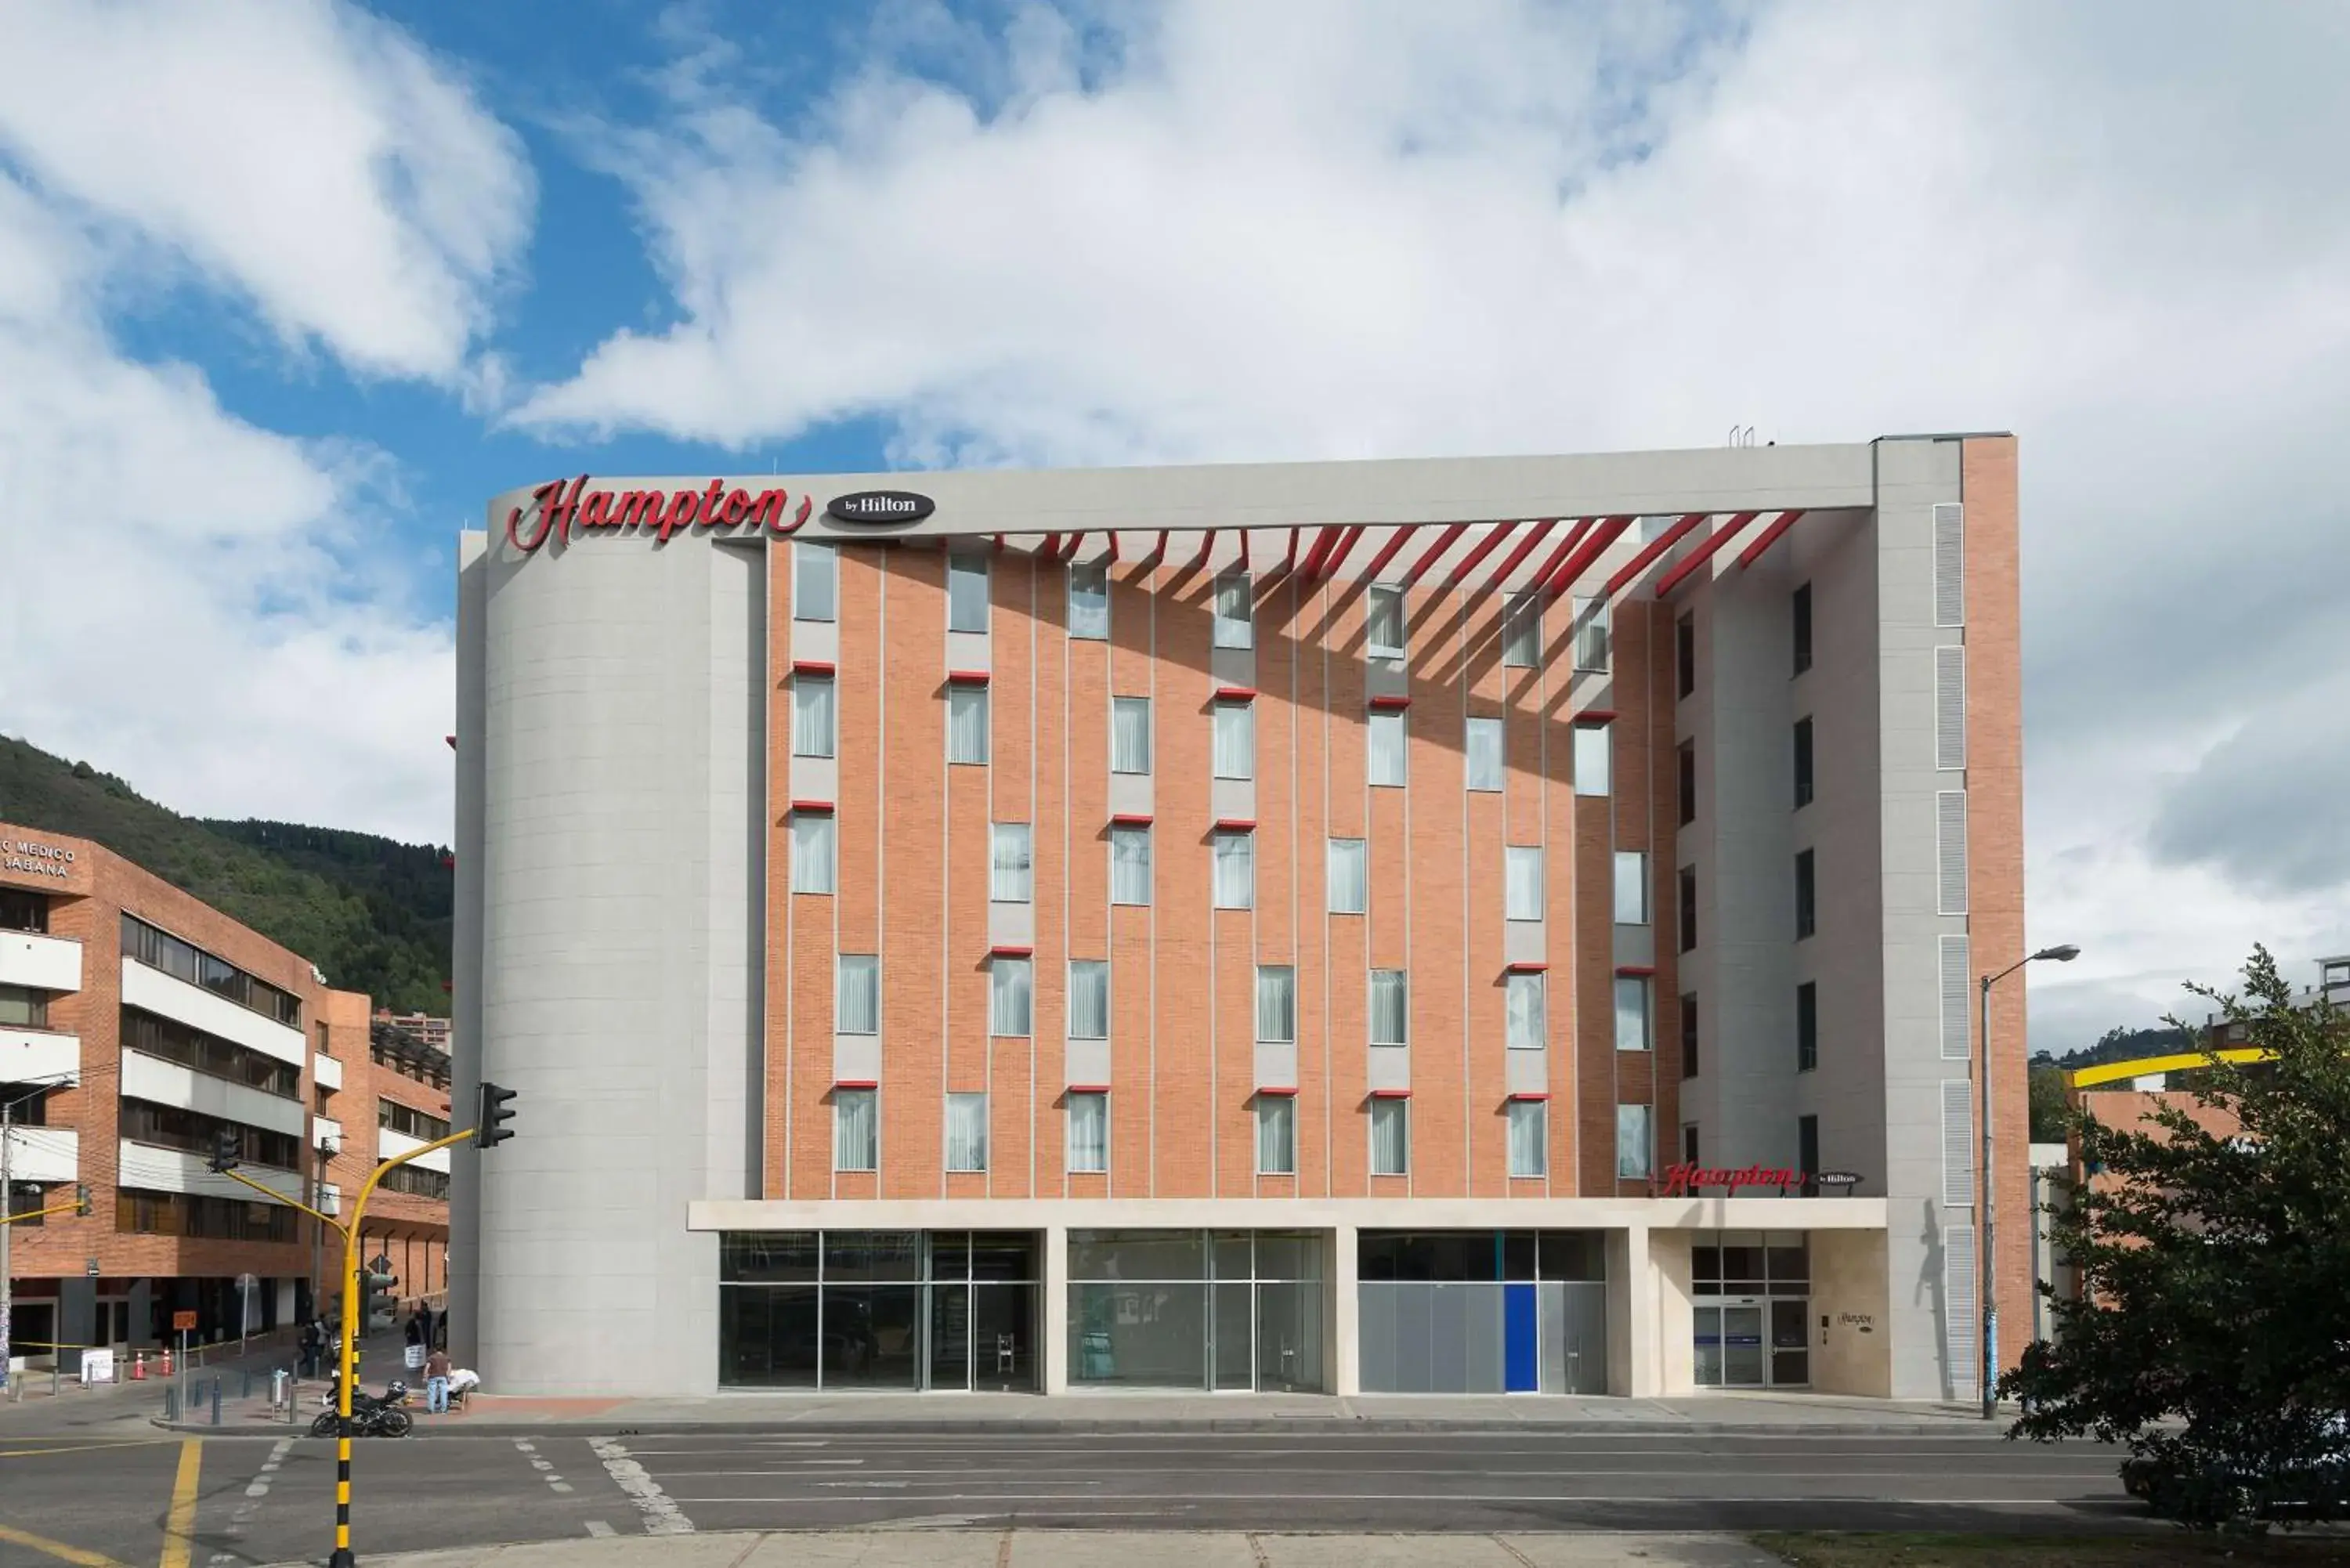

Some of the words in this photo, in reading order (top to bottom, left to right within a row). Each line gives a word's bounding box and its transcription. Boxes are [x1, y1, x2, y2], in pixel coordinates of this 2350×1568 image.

[505, 473, 812, 552] Hampton
[845, 500, 858, 512] by
[861, 495, 916, 512] Hilton
[1648, 1161, 1806, 1195] Hampton
